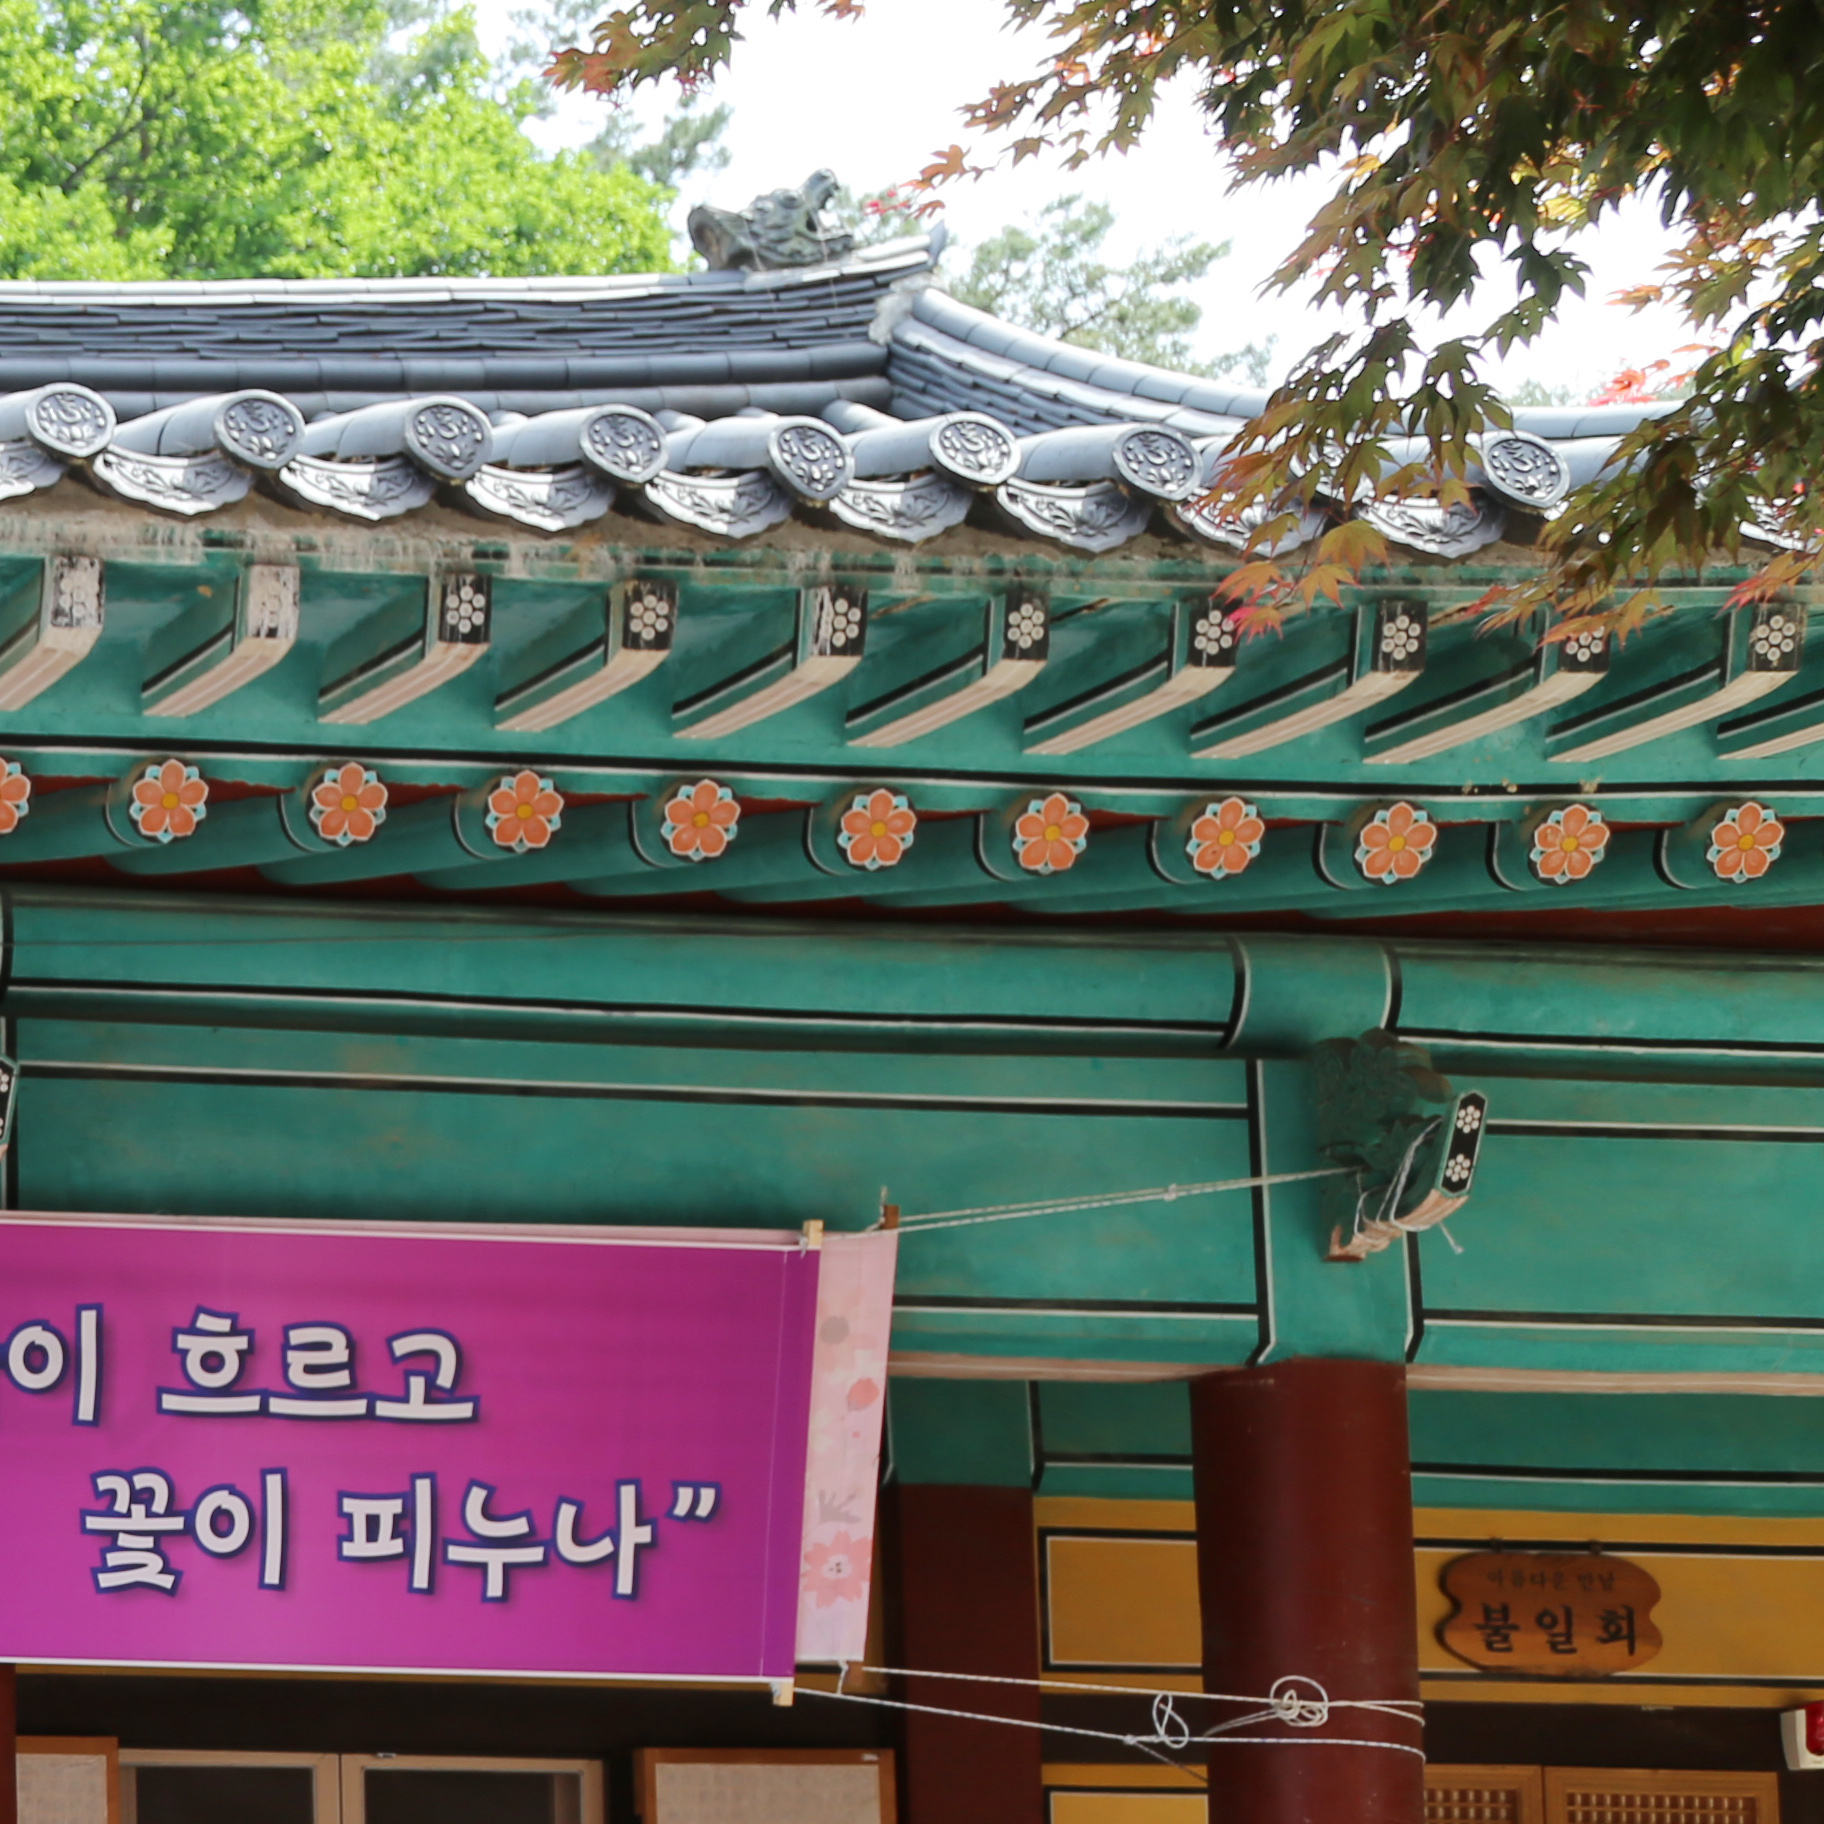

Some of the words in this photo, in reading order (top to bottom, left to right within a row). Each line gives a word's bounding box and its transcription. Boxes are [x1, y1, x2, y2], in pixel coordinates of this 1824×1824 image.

[156, 1306, 481, 1424] 흐르고
[80, 1467, 289, 1597] 꽃이
[1474, 1602, 1637, 1657] 불일회
